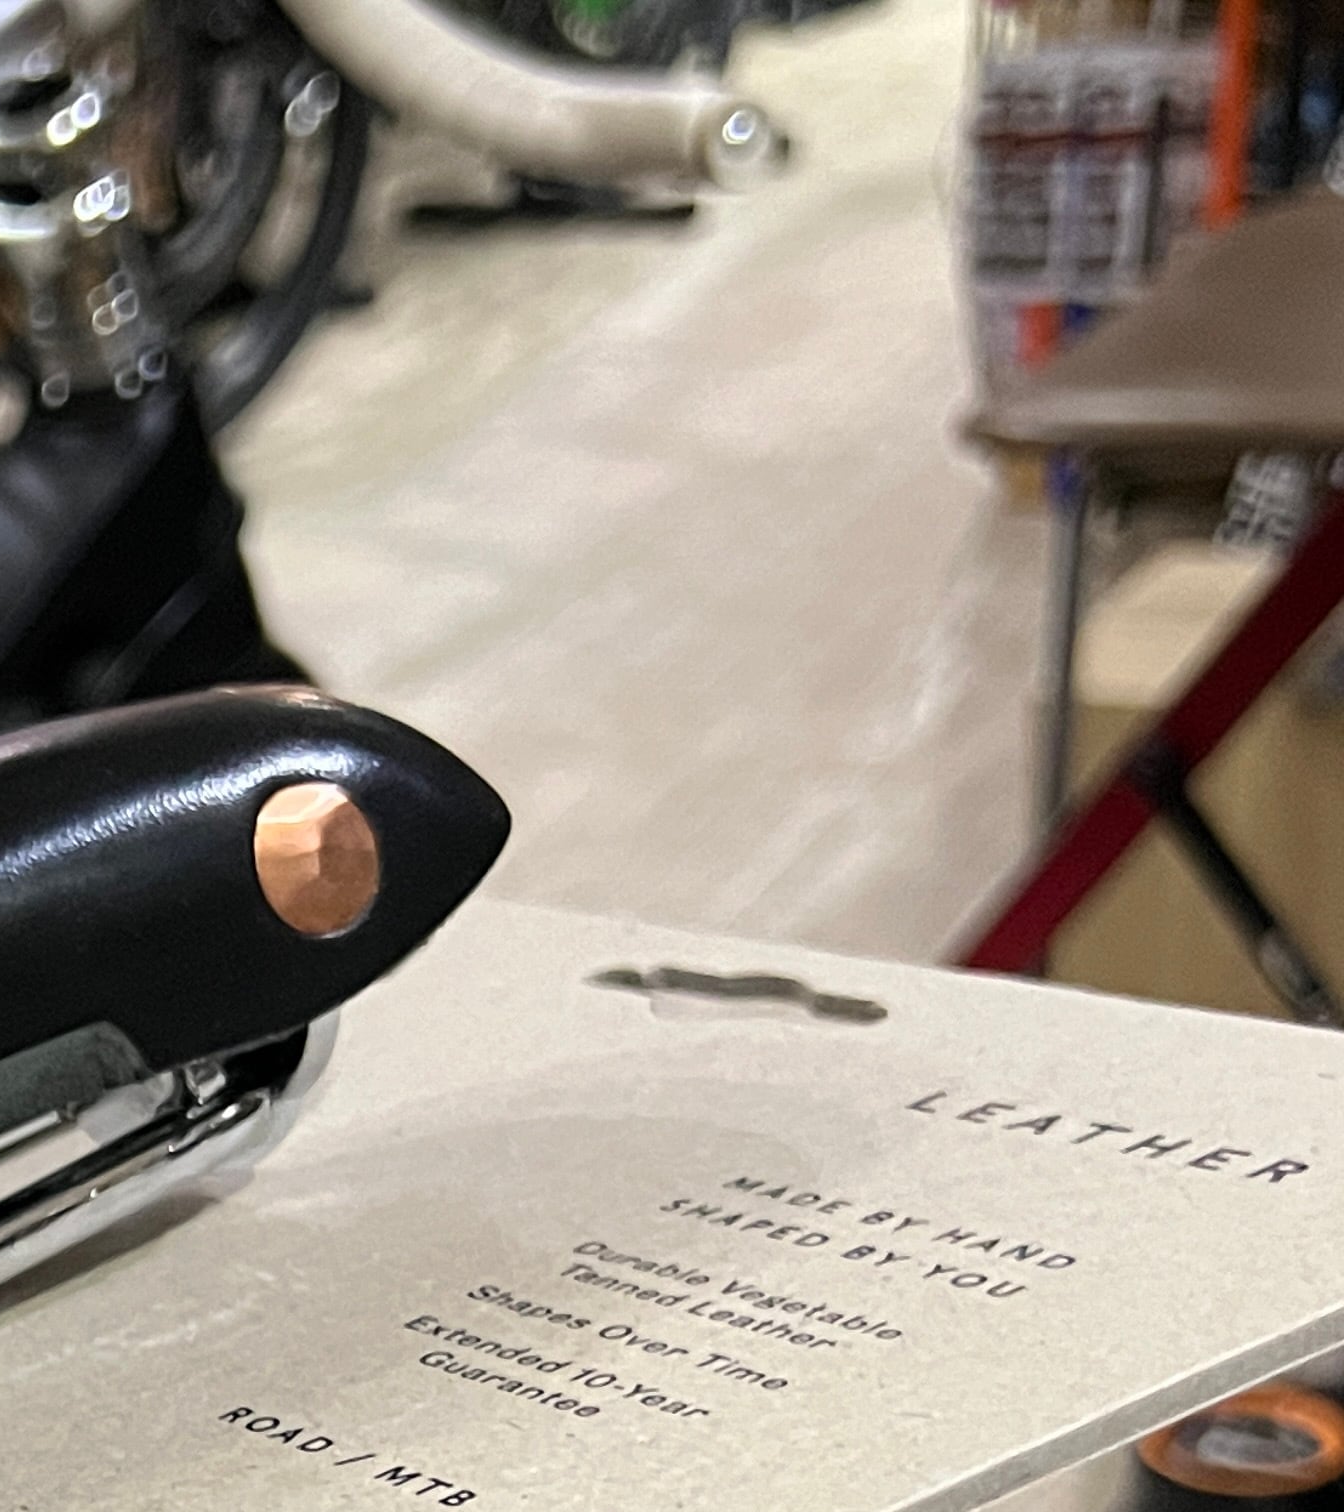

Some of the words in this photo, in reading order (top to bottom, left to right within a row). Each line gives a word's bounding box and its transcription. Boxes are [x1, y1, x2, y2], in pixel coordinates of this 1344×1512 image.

[908, 1091, 1310, 1184] LEATHER
[659, 1199, 830, 1249] SHAPED
[841, 1244, 912, 1268] BY
[923, 1263, 1028, 1299] YOU
[723, 1176, 852, 1214] MADE
[860, 1211, 929, 1232] BY
[933, 1228, 1076, 1271] HAND
[467, 1284, 592, 1331] Shapes
[598, 1324, 690, 1359] Over
[697, 1353, 789, 1391] Time
[561, 1263, 692, 1308] Tanned
[687, 1301, 838, 1351] Leather
[573, 1241, 710, 1287] Durable
[721, 1280, 904, 1341] Vegetable
[404, 1314, 566, 1374] Extended
[569, 1368, 710, 1420] 10-Year
[418, 1350, 602, 1419] Guarantee
[218, 1406, 334, 1452] ROAD
[374, 1465, 477, 1507] MTB
